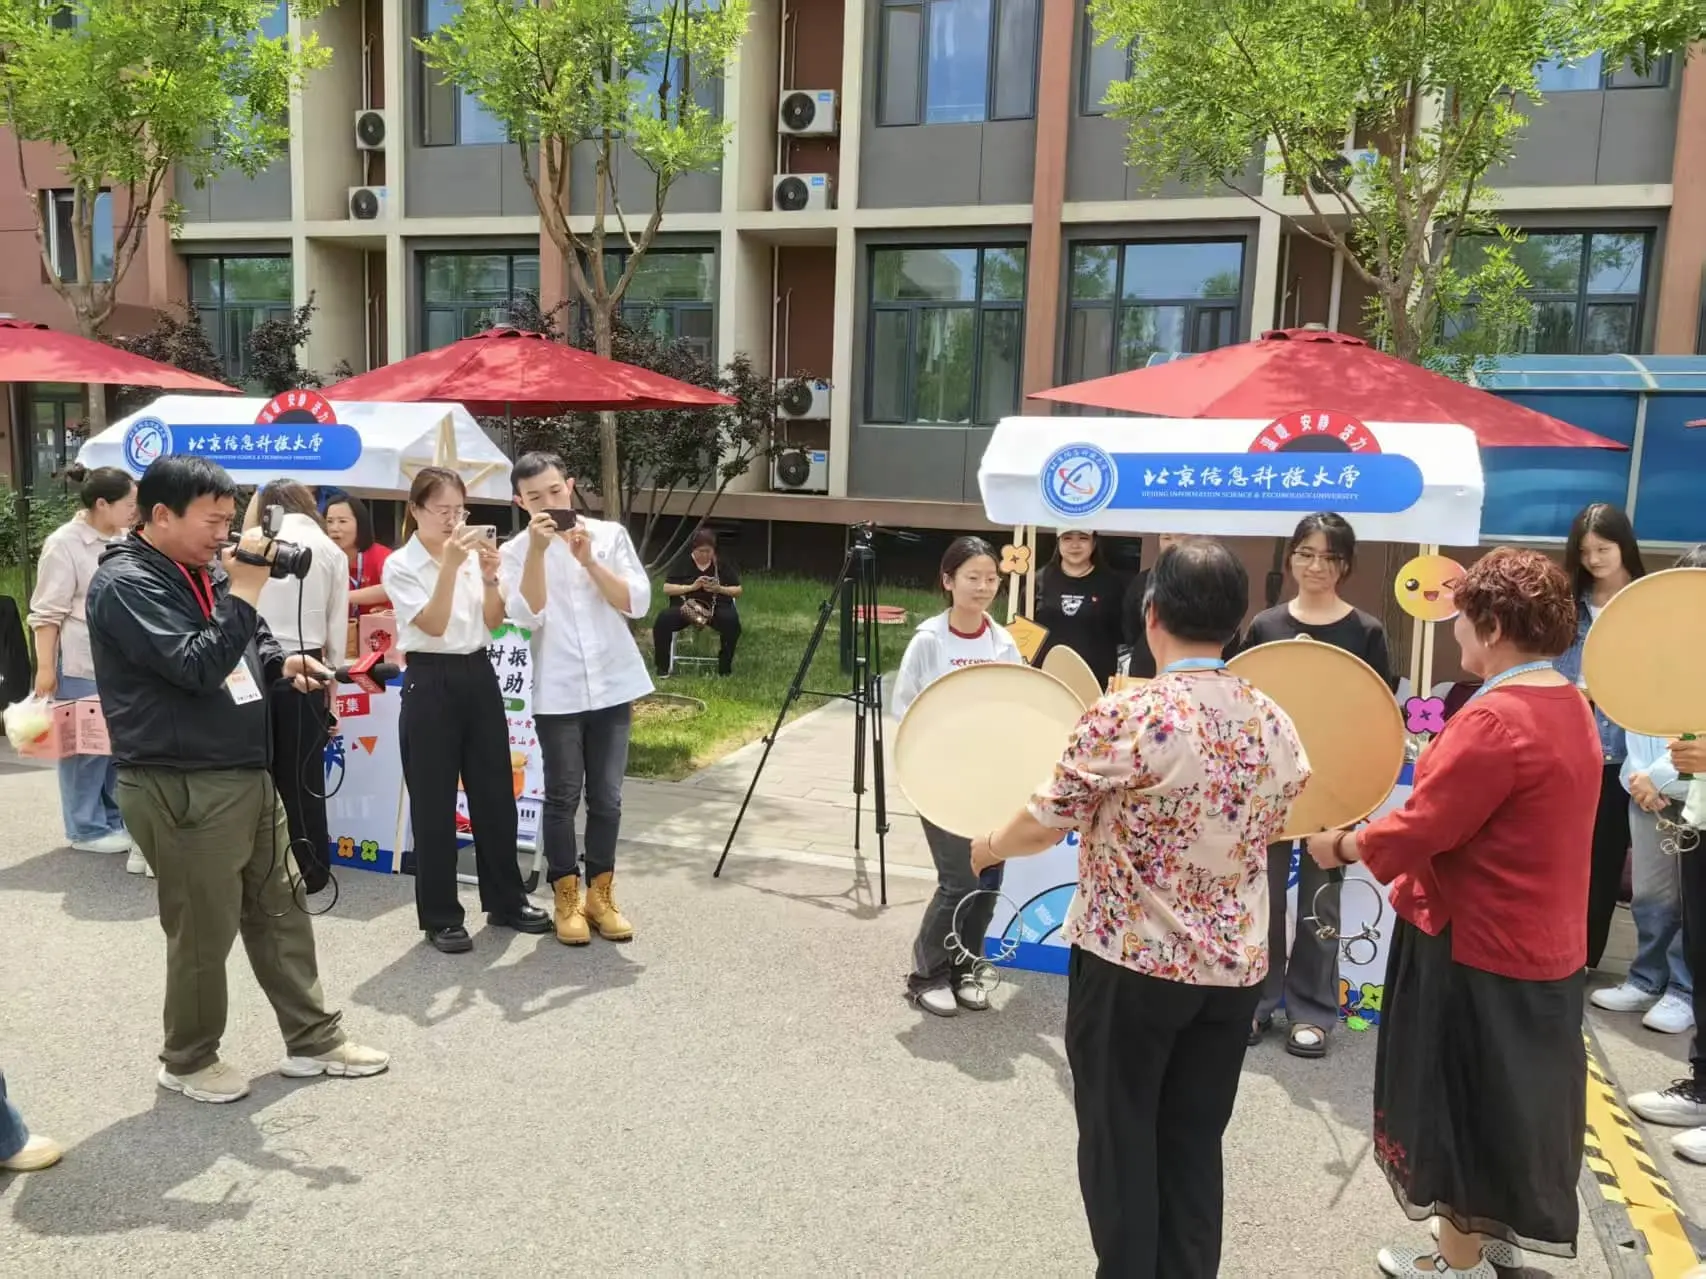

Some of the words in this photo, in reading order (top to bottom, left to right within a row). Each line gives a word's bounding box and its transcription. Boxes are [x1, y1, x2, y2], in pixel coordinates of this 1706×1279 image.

[188, 433, 324, 453] 北京信息科技大学
[1143, 464, 1361, 490] 北京信息科技大学
